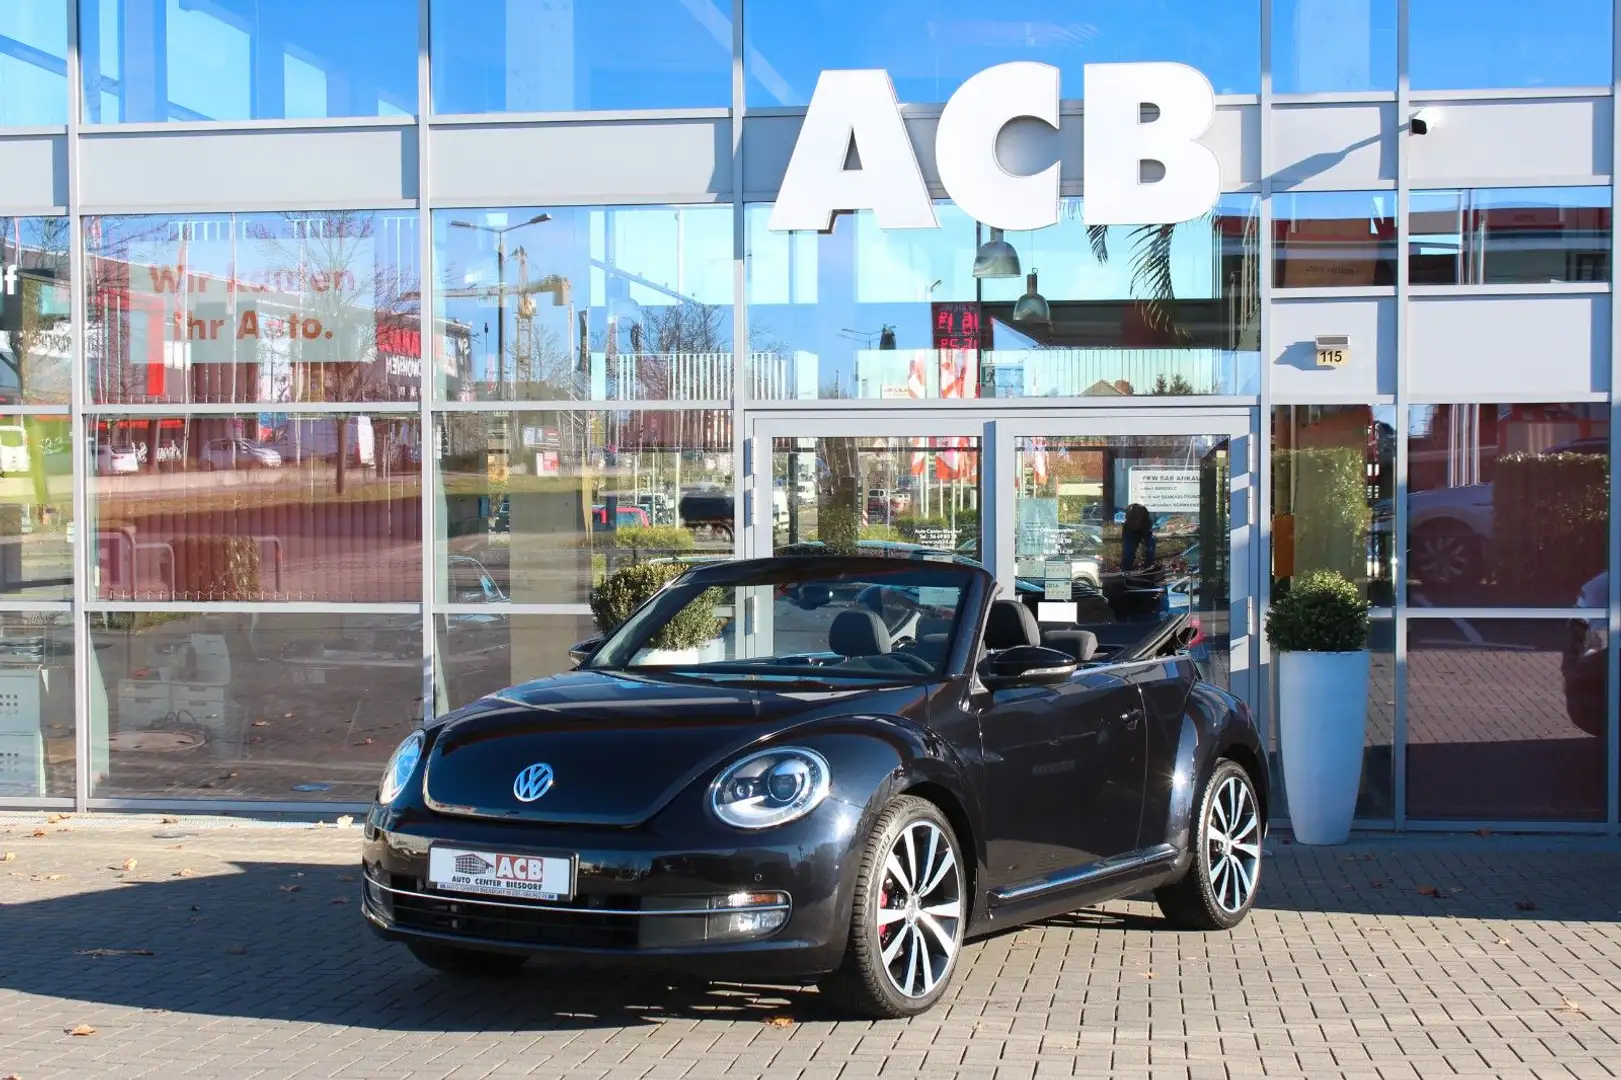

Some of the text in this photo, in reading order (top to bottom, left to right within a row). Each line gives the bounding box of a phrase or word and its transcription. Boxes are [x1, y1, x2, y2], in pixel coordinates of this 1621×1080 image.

[768, 61, 1222, 233] ACB
[0, 264, 18, 295] f
[1319, 350, 1343, 363] 115
[496, 856, 543, 881] ACB
[451, 875, 543, 891] AUTO CENTER BIESDORF
